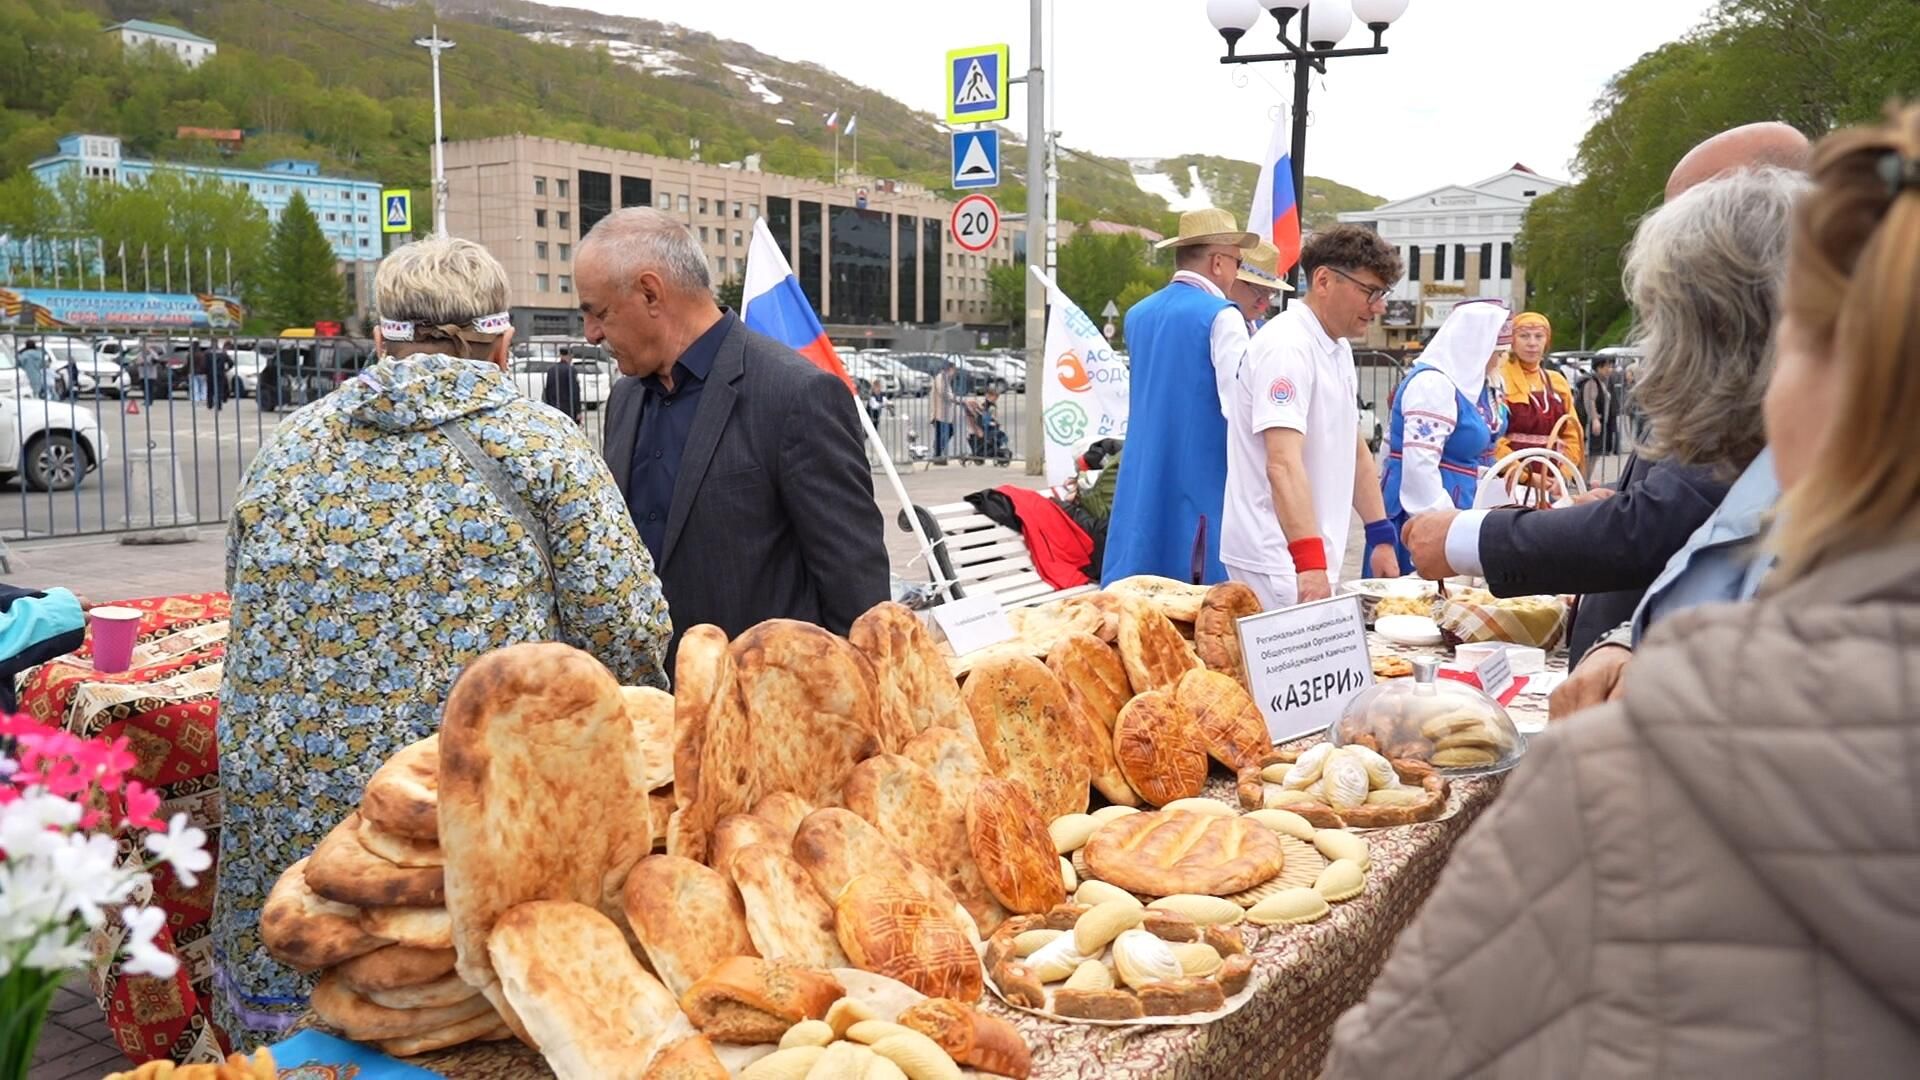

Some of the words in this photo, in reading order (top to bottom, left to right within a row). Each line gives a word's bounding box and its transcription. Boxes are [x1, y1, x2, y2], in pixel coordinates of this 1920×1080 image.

[962, 211, 989, 235] 20
[1256, 627, 1305, 645] Региональная
[1261, 641, 1312, 660] Общественная
[1312, 629, 1355, 647] Организация
[1266, 653, 1324, 675] Азербайджанцев
[1325, 644, 1357, 658] Камчатки
[1270, 667, 1364, 712] «АЗЕРИ»
